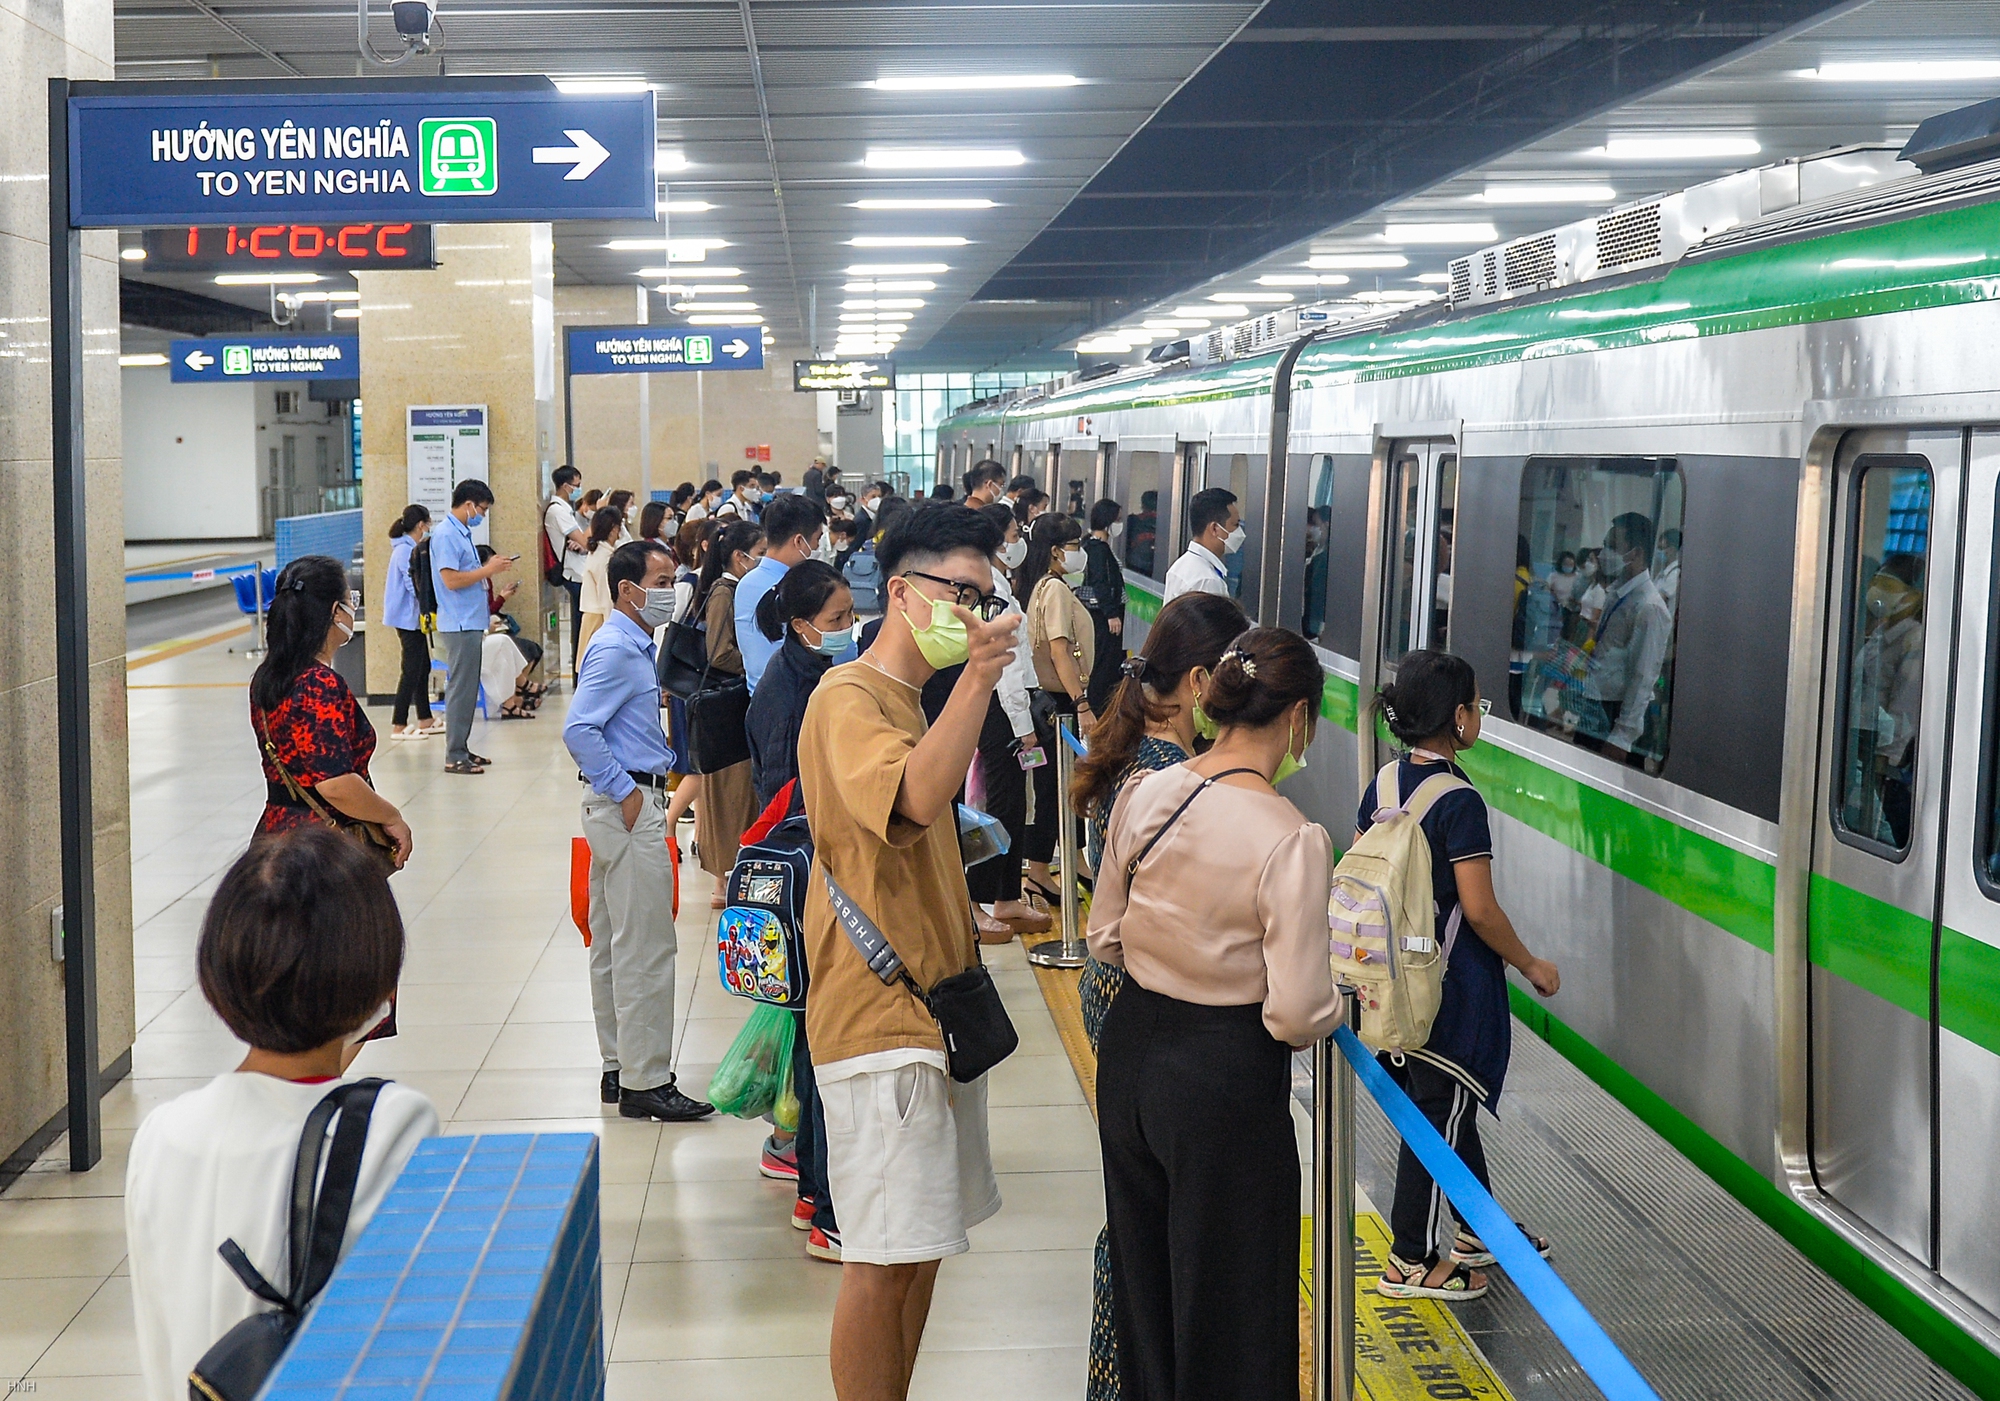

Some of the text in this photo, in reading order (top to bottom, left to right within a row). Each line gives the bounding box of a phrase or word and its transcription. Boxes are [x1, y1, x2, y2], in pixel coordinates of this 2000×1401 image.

[152, 120, 410, 161] HƯỚNG YÊN NGHĨA
[196, 169, 410, 196] TO YEN NGHIA
[253, 344, 341, 361] HƯỚNG YÊN NGHĨA
[596, 336, 683, 353] HƯỚNG YÊN NGHĨA
[253, 362, 323, 372] TO YEN NGHIA
[611, 354, 683, 365] TO YEN NGHIA
[1373, 1305, 1439, 1354] KHE
